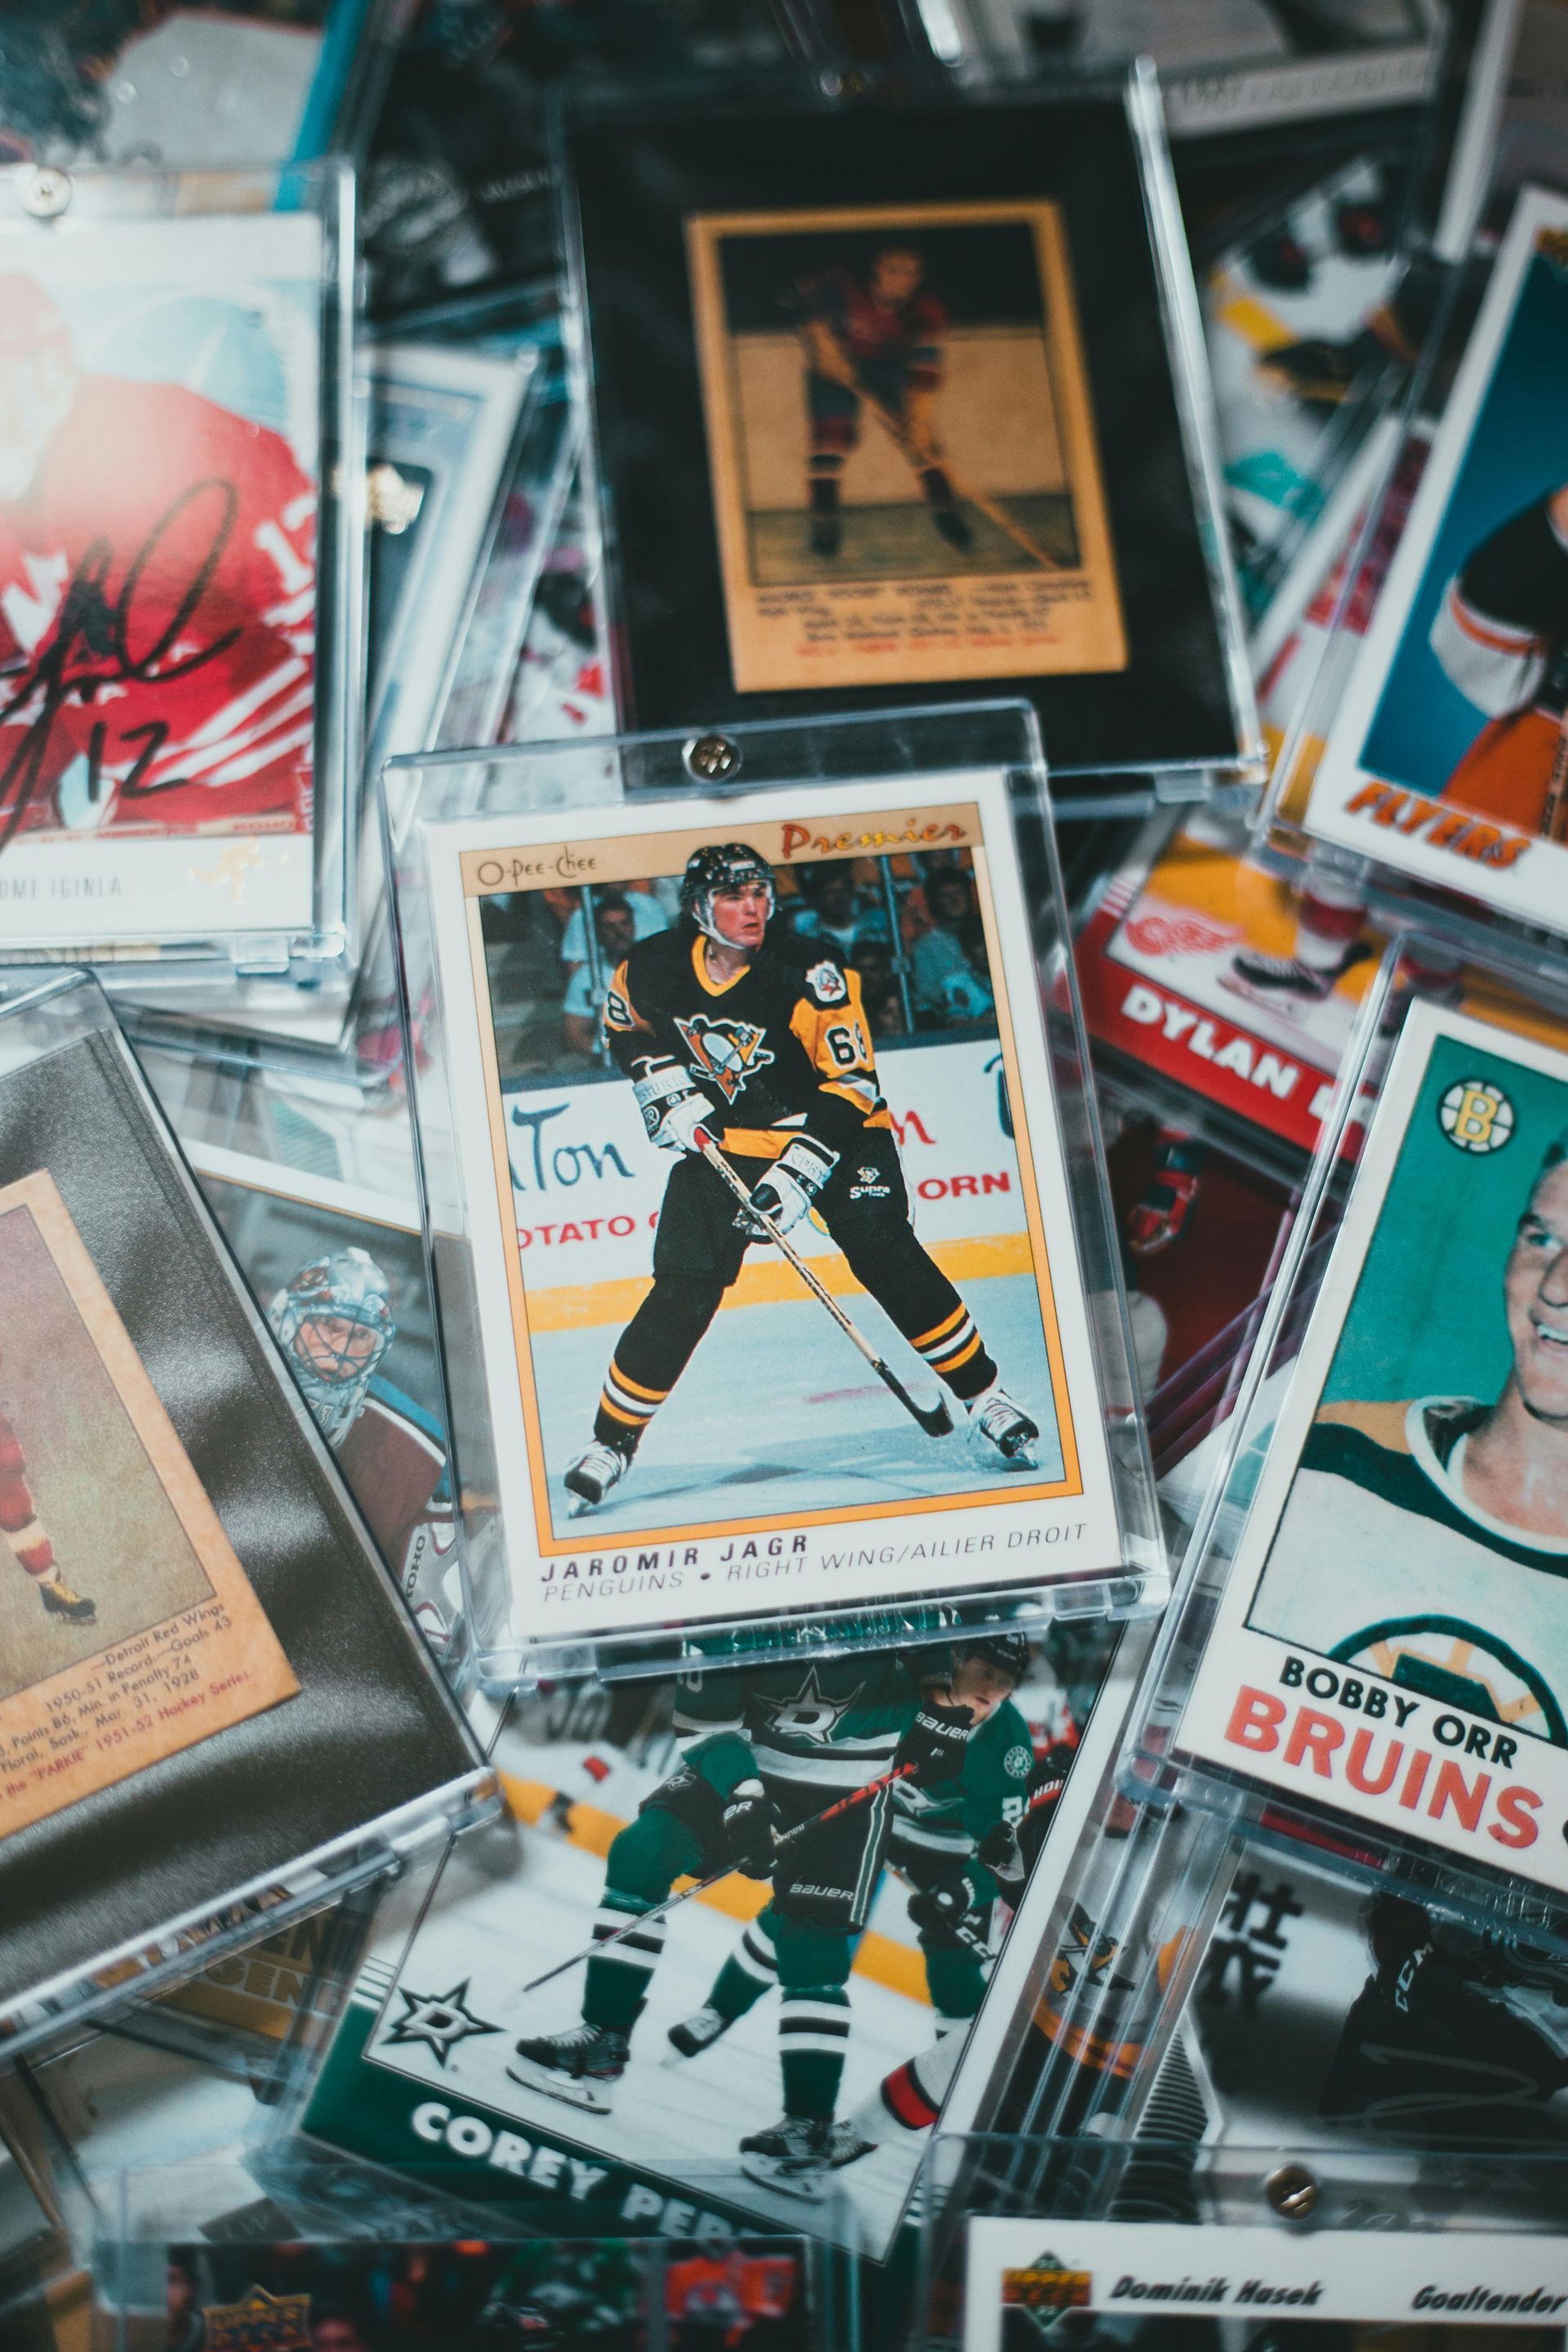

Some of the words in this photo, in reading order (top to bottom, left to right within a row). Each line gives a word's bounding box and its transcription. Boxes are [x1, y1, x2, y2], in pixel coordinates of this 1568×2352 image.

[87, 720, 192, 802] 12
[782, 817, 967, 859] Premier
[1345, 781, 1532, 870] FLYERS
[51, 876, 122, 898] IGINLA
[1120, 983, 1301, 1100] DYLAN
[917, 1171, 1012, 1201] ORN
[541, 1547, 699, 1583] JAROMIR
[719, 1534, 808, 1562] JAGR
[543, 1570, 684, 1603] PENGUINS
[727, 1556, 809, 1582] RIGHT
[820, 1534, 996, 1572] WING/AILIER
[1007, 1522, 1088, 1549] DROIT
[153, 1622, 180, 1643] Red
[182, 1604, 225, 1627] Wings
[11, 1726, 50, 1750] Points
[108, 1691, 121, 1703] in
[121, 1665, 172, 1695] Penalty
[172, 1654, 192, 1671] 74
[45, 1677, 103, 1713] 1950-51
[213, 1615, 233, 1632] 43
[163, 1668, 199, 1693] 1928
[94, 1715, 154, 1751] 1951-52
[158, 1690, 206, 1721] Hockey
[1278, 1655, 1421, 1729] BOBBY
[1432, 1714, 1518, 1770] ORR
[1223, 1684, 1544, 1850] BRUINS
[1395, 1941, 1434, 2013] CCM
[411, 2101, 610, 2202] COREY
[1109, 2274, 1231, 2302] Dominik
[1233, 2278, 1325, 2306] Hasek
[1411, 2283, 1568, 2313] Goaltender
